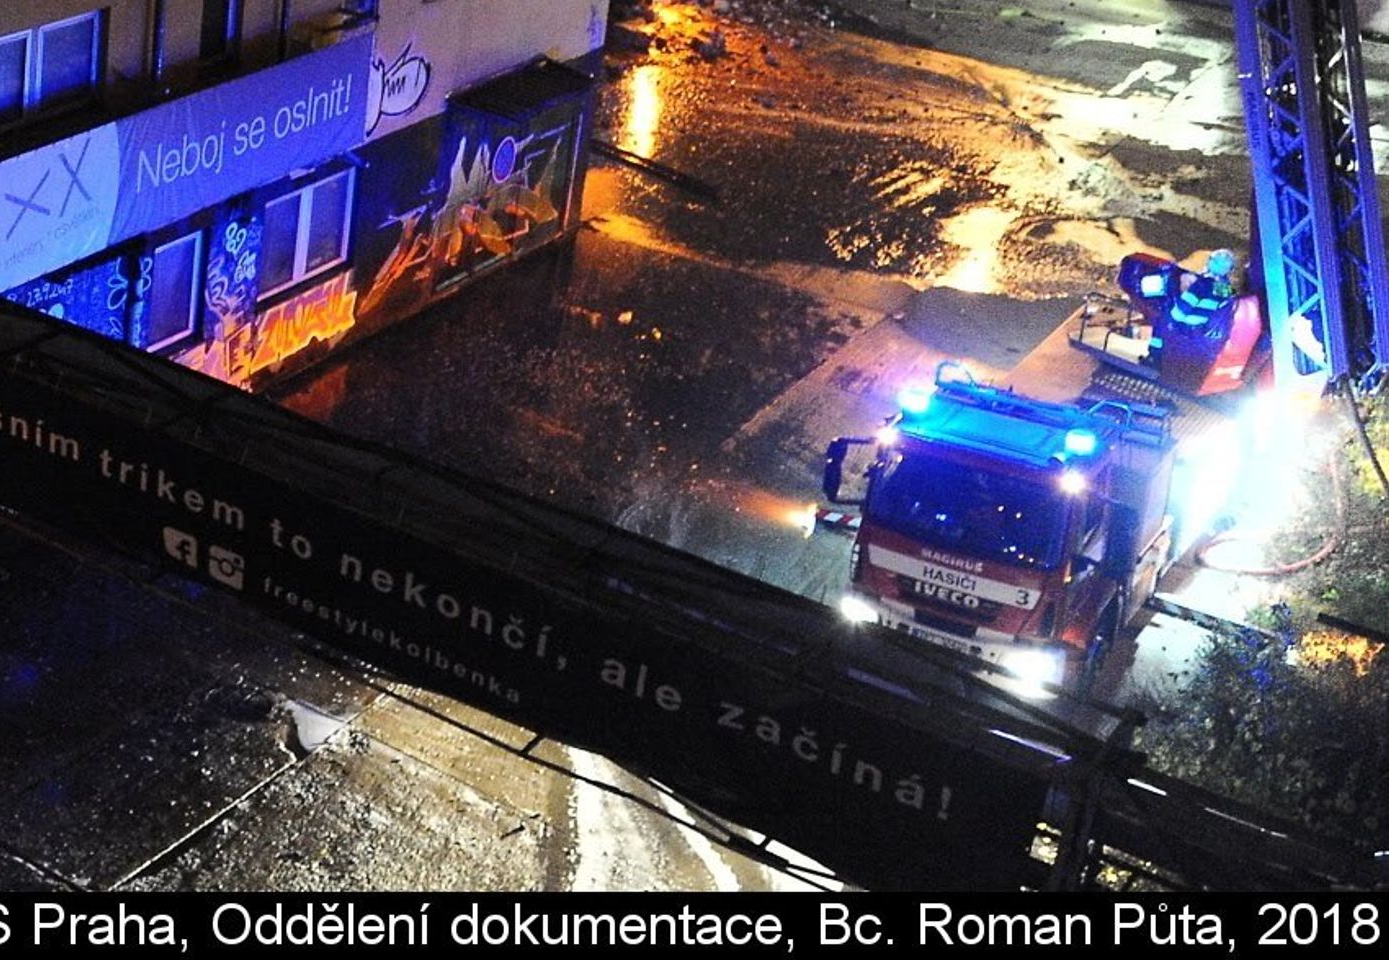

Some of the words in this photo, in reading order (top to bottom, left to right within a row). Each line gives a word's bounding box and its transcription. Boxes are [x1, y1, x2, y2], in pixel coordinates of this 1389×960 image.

[136, 124, 226, 193] Neboj
[233, 120, 266, 159] se
[273, 73, 353, 136] oslnit!
[914, 580, 980, 609] IVECO
[921, 547, 984, 572] MAGIRUS
[922, 565, 977, 591] HASIČI
[1015, 589, 1030, 606] 3
[100, 448, 245, 530] trikem
[270, 518, 313, 560] to
[340, 548, 569, 672] nekončí,
[600, 654, 683, 712] ale
[717, 700, 953, 821] začíná!
[262, 575, 521, 705] freestylekolbenka
